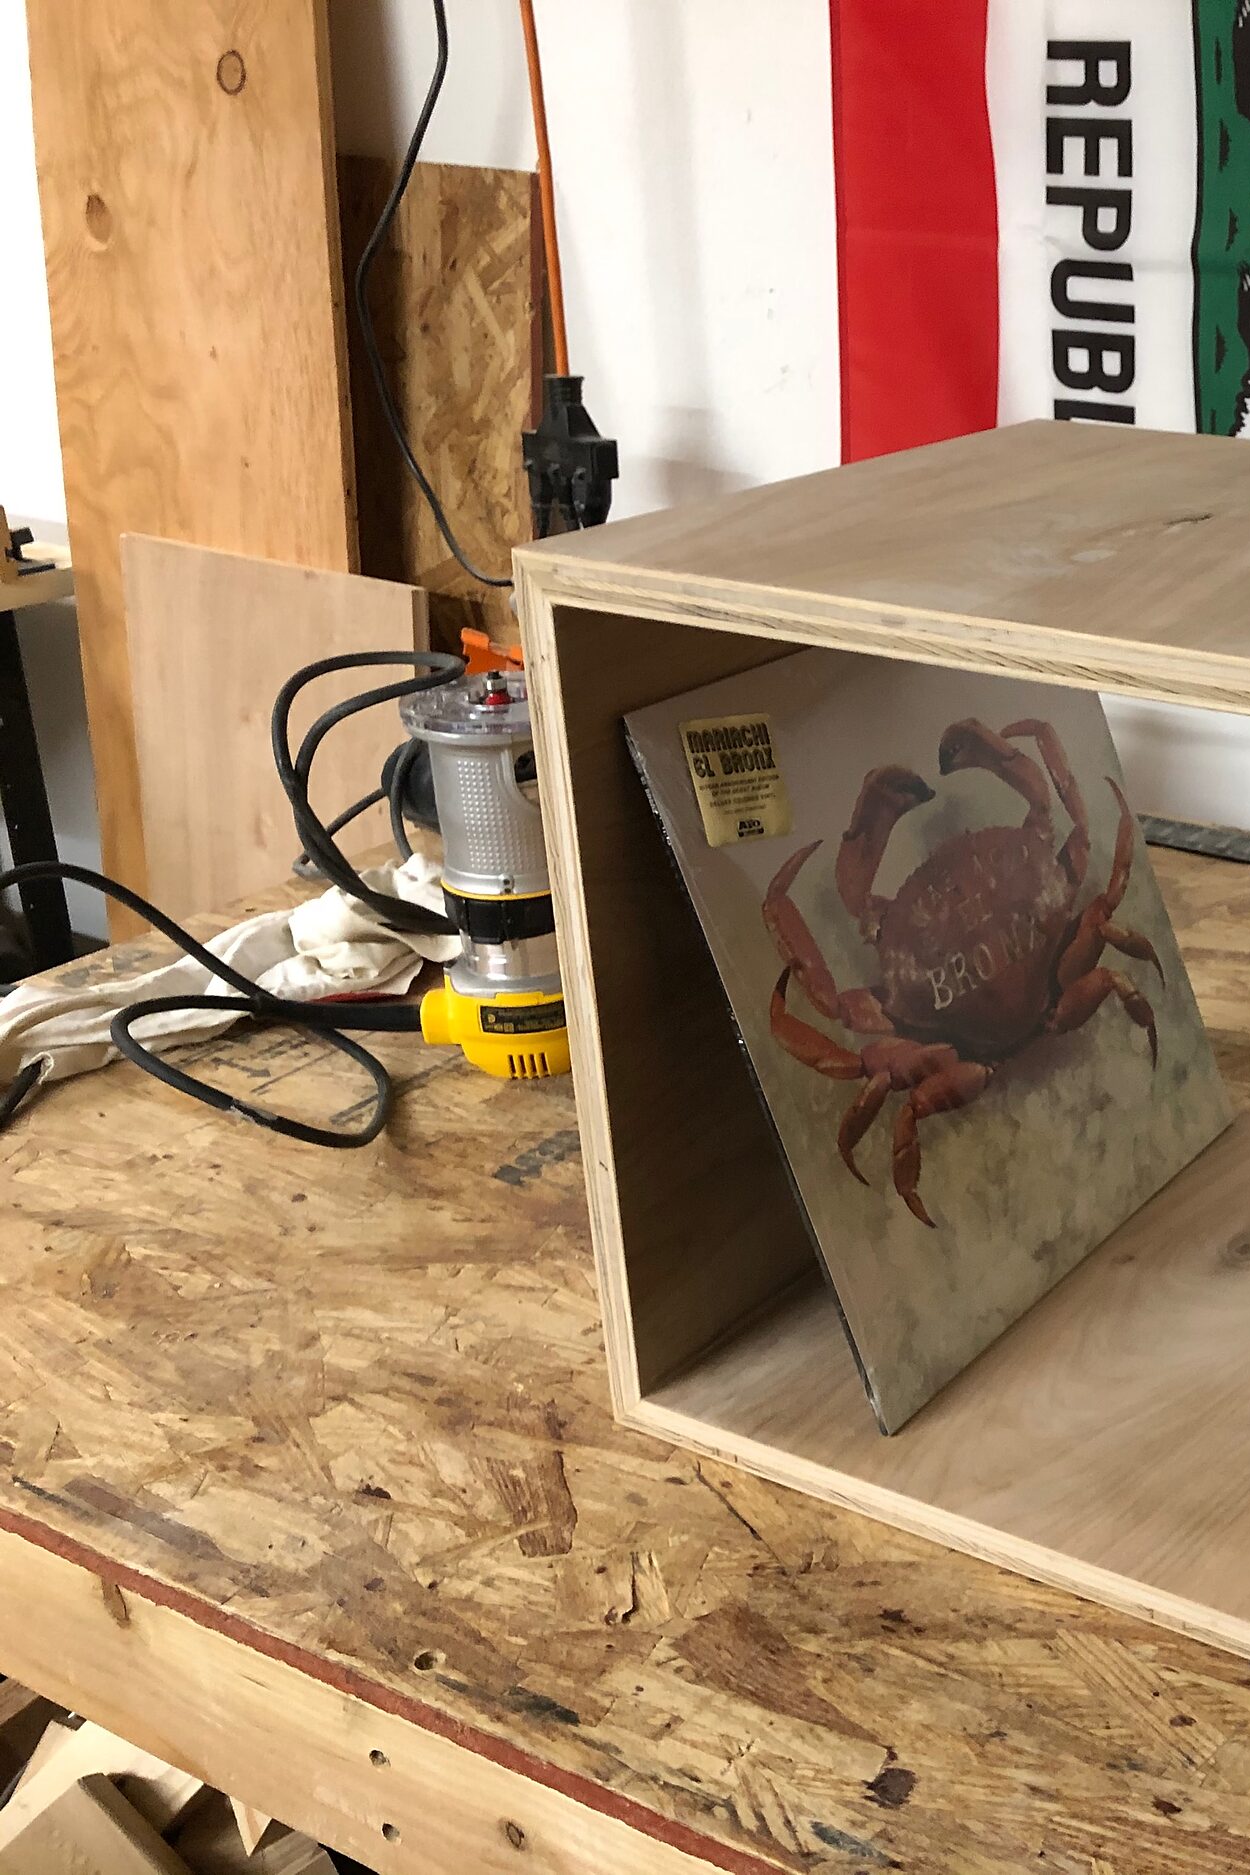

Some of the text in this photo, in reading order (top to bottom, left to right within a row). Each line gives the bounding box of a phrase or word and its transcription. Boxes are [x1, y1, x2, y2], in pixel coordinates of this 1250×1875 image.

[686, 722, 771, 754] MARIACHI
[692, 746, 776, 778] EL BRONX
